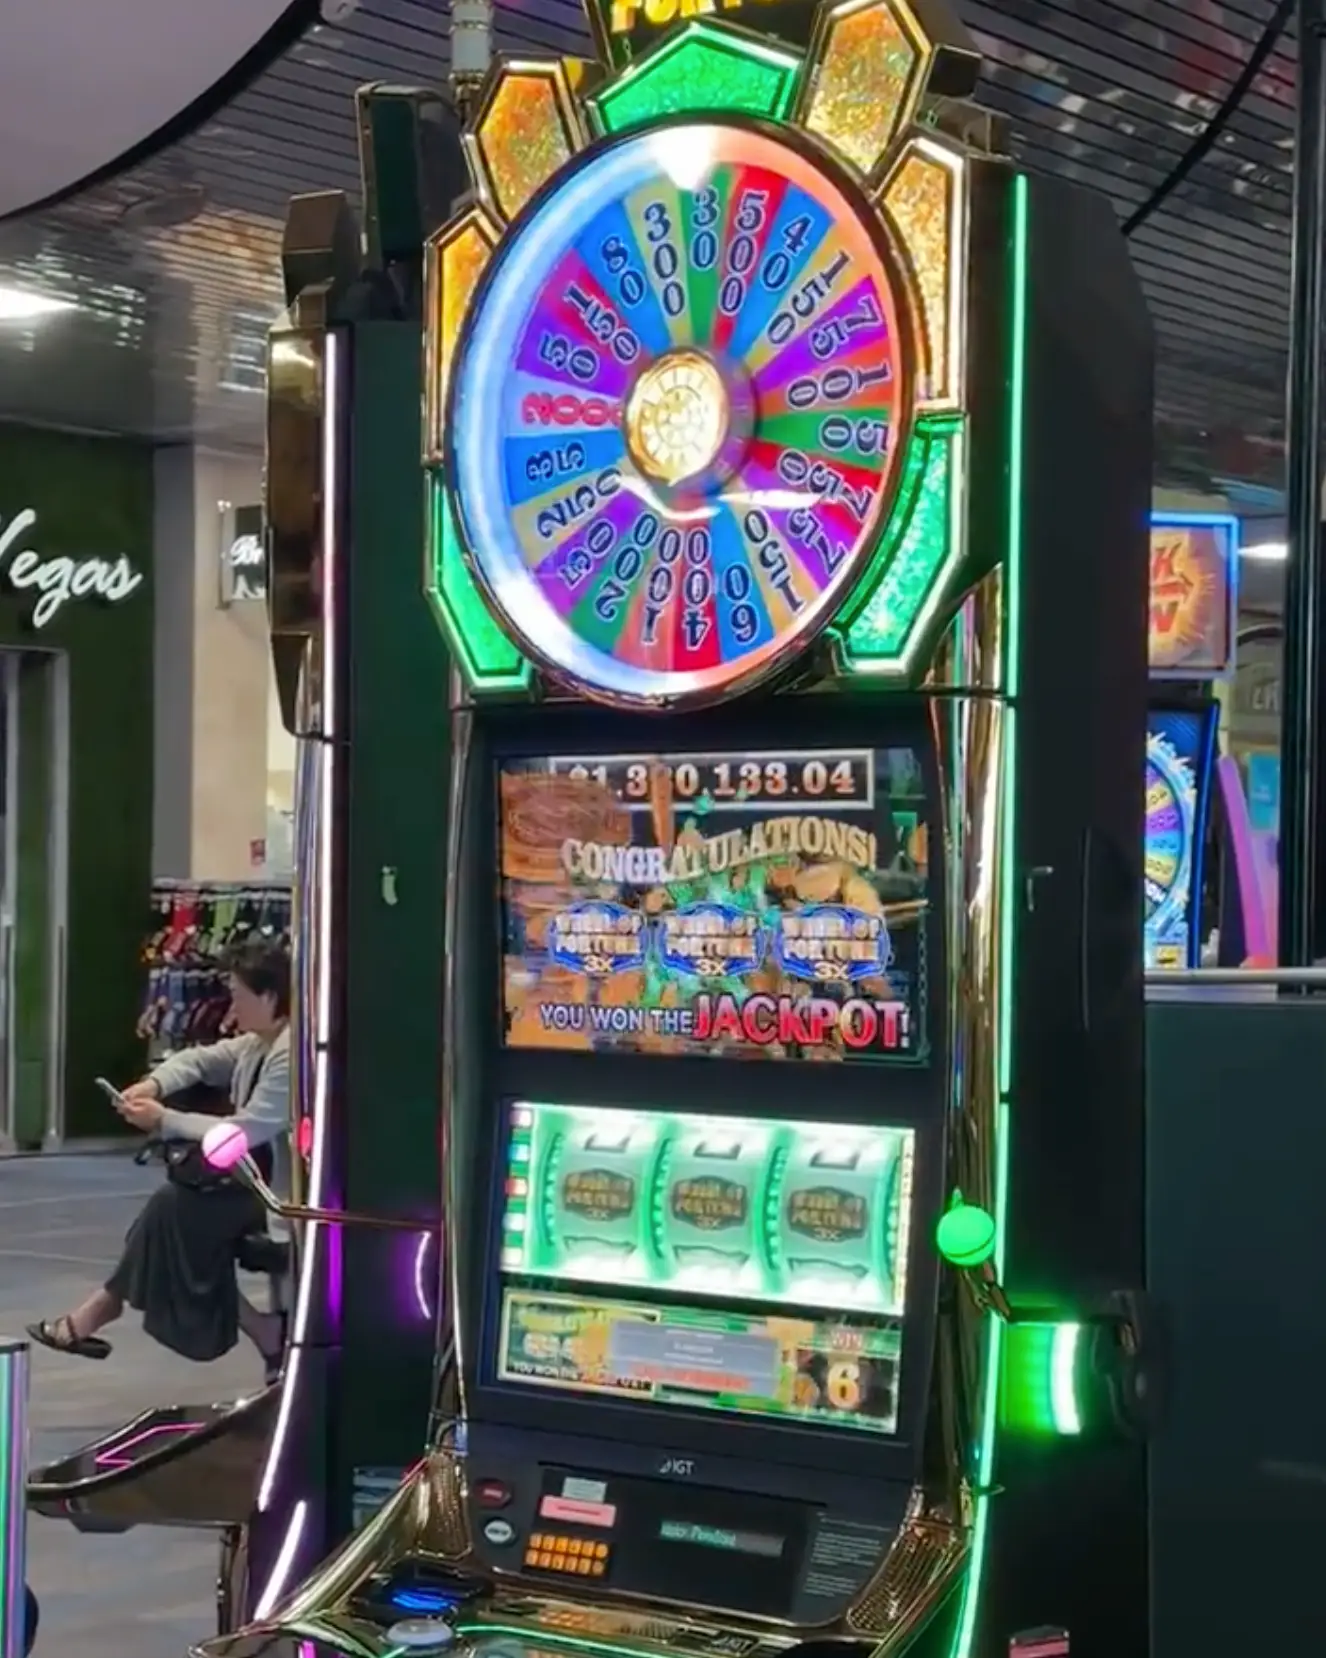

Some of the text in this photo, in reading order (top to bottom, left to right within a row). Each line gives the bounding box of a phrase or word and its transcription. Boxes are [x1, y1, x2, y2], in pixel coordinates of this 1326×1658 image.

[644, 202, 686, 316] 300
[691, 184, 720, 271] 30
[719, 189, 769, 315] 500
[760, 213, 815, 291] 40
[601, 235, 646, 309] 80
[766, 249, 854, 345] 150
[540, 329, 597, 380] 50
[563, 280, 640, 365] 150
[809, 293, 882, 358] 75
[786, 360, 892, 409] 100
[525, 442, 585, 482] 35
[819, 414, 889, 455] 50
[537, 467, 622, 539] 250
[777, 448, 877, 522] 750
[558, 518, 616, 591] 50
[594, 511, 661, 621] 200
[743, 507, 806, 614] 150
[787, 507, 851, 576] 75
[641, 528, 683, 645] 100
[684, 527, 712, 652] 400
[723, 562, 760, 646] 60
[560, 816, 878, 884] CONGRATULATIONS!
[583, 955, 615, 973] 3X
[695, 957, 727, 977] 3X
[813, 961, 849, 979] 3X
[540, 992, 910, 1049] YOU WON THE JACKPOT!
[827, 1362, 860, 1409] 6
[672, 1459, 695, 1475] IGT
